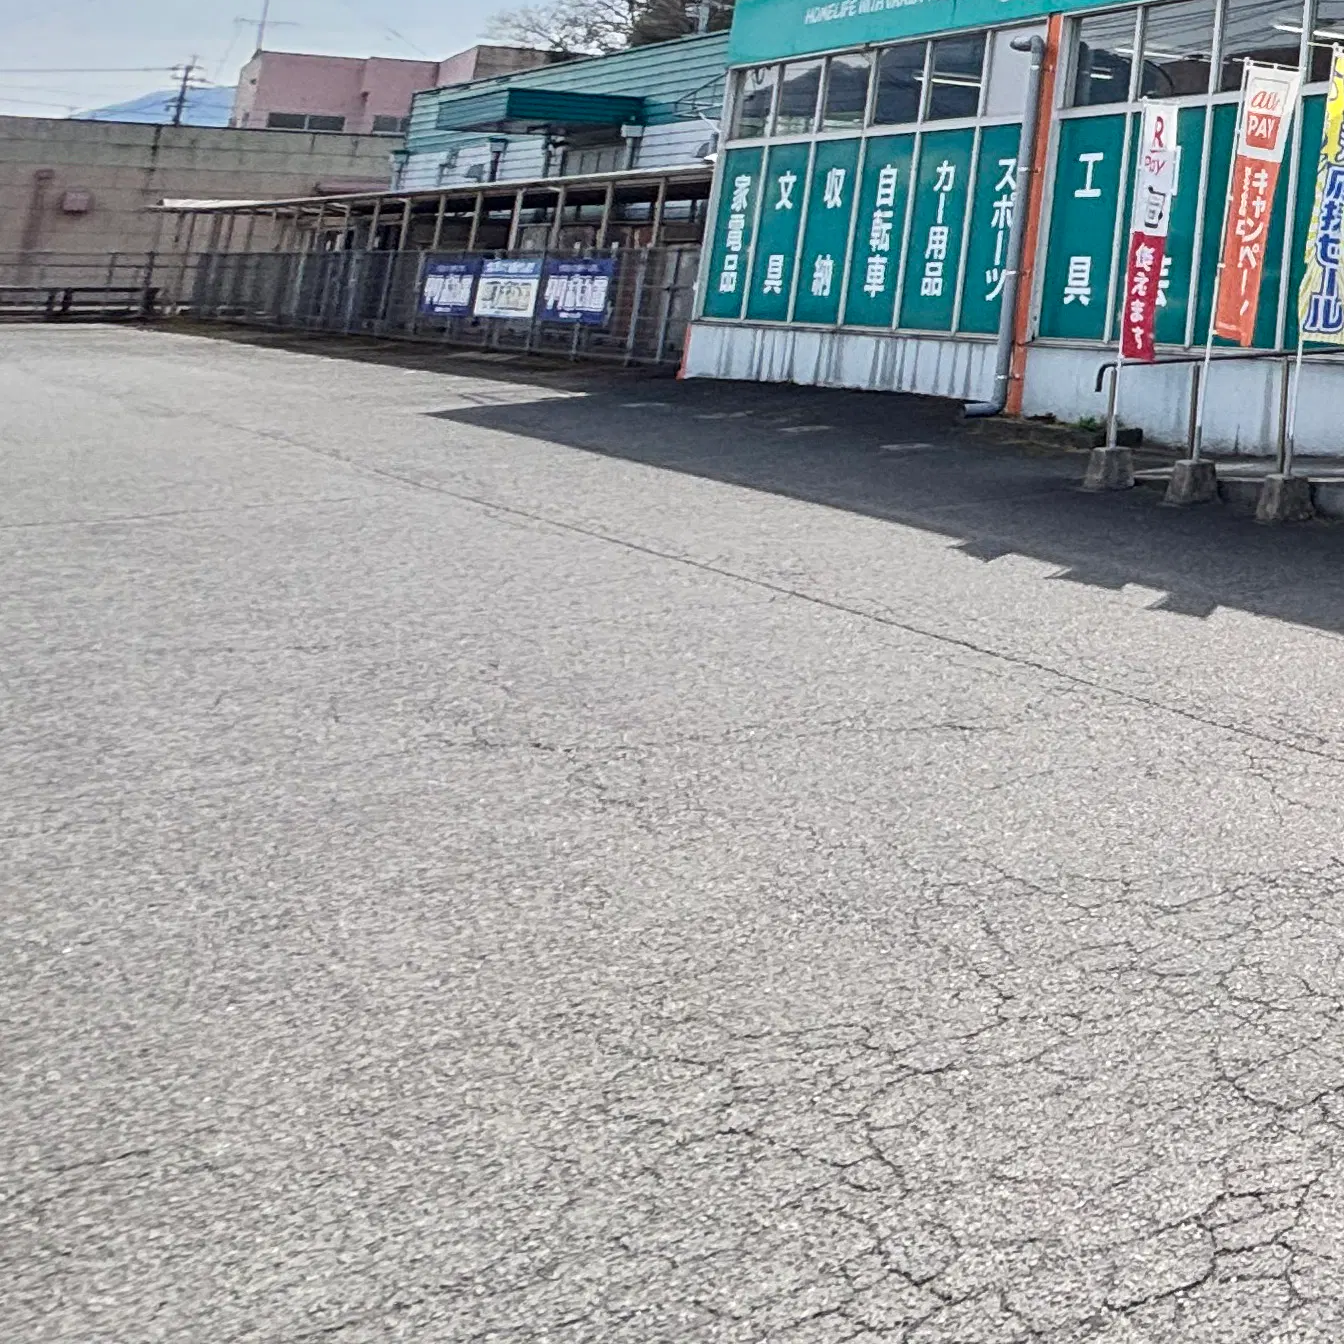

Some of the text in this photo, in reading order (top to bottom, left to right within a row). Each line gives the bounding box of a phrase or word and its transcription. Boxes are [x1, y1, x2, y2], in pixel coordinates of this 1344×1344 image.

[1247, 114, 1276, 137] PAY
[1251, 90, 1281, 109] au
[763, 170, 798, 295] 文具
[810, 167, 847, 297] 収納
[863, 163, 898, 298] 自転車
[920, 159, 957, 297] カー用品
[985, 158, 1017, 302] スポーツ
[1063, 152, 1104, 306] 工具
